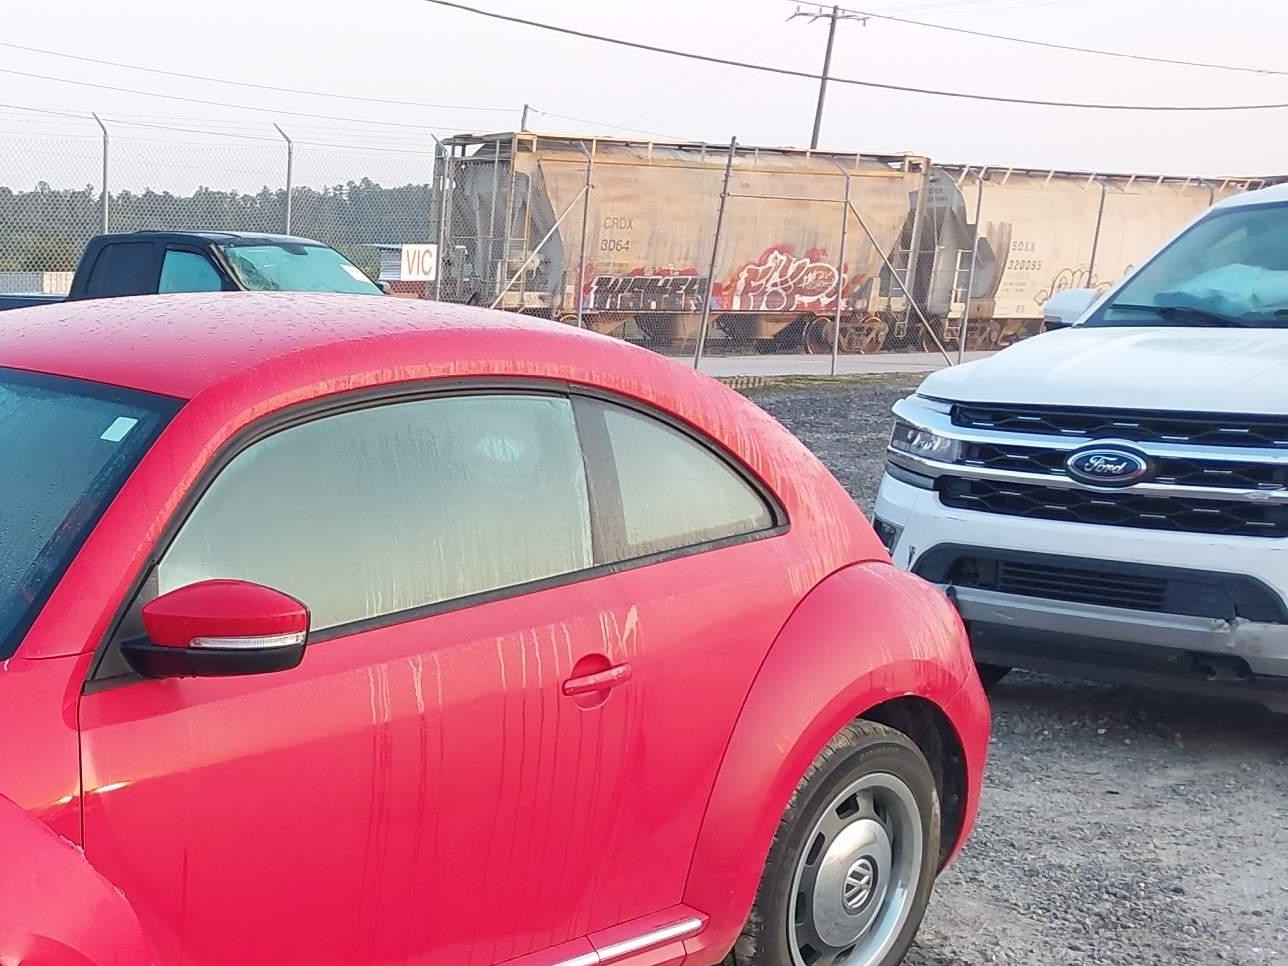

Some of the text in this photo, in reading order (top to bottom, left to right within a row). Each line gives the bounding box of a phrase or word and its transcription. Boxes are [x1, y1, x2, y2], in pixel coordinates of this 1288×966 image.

[604, 217, 633, 230] CRDX
[600, 239, 630, 252] 3064
[406, 249, 433, 275] VIC
[1084, 455, 1128, 474] Ford
